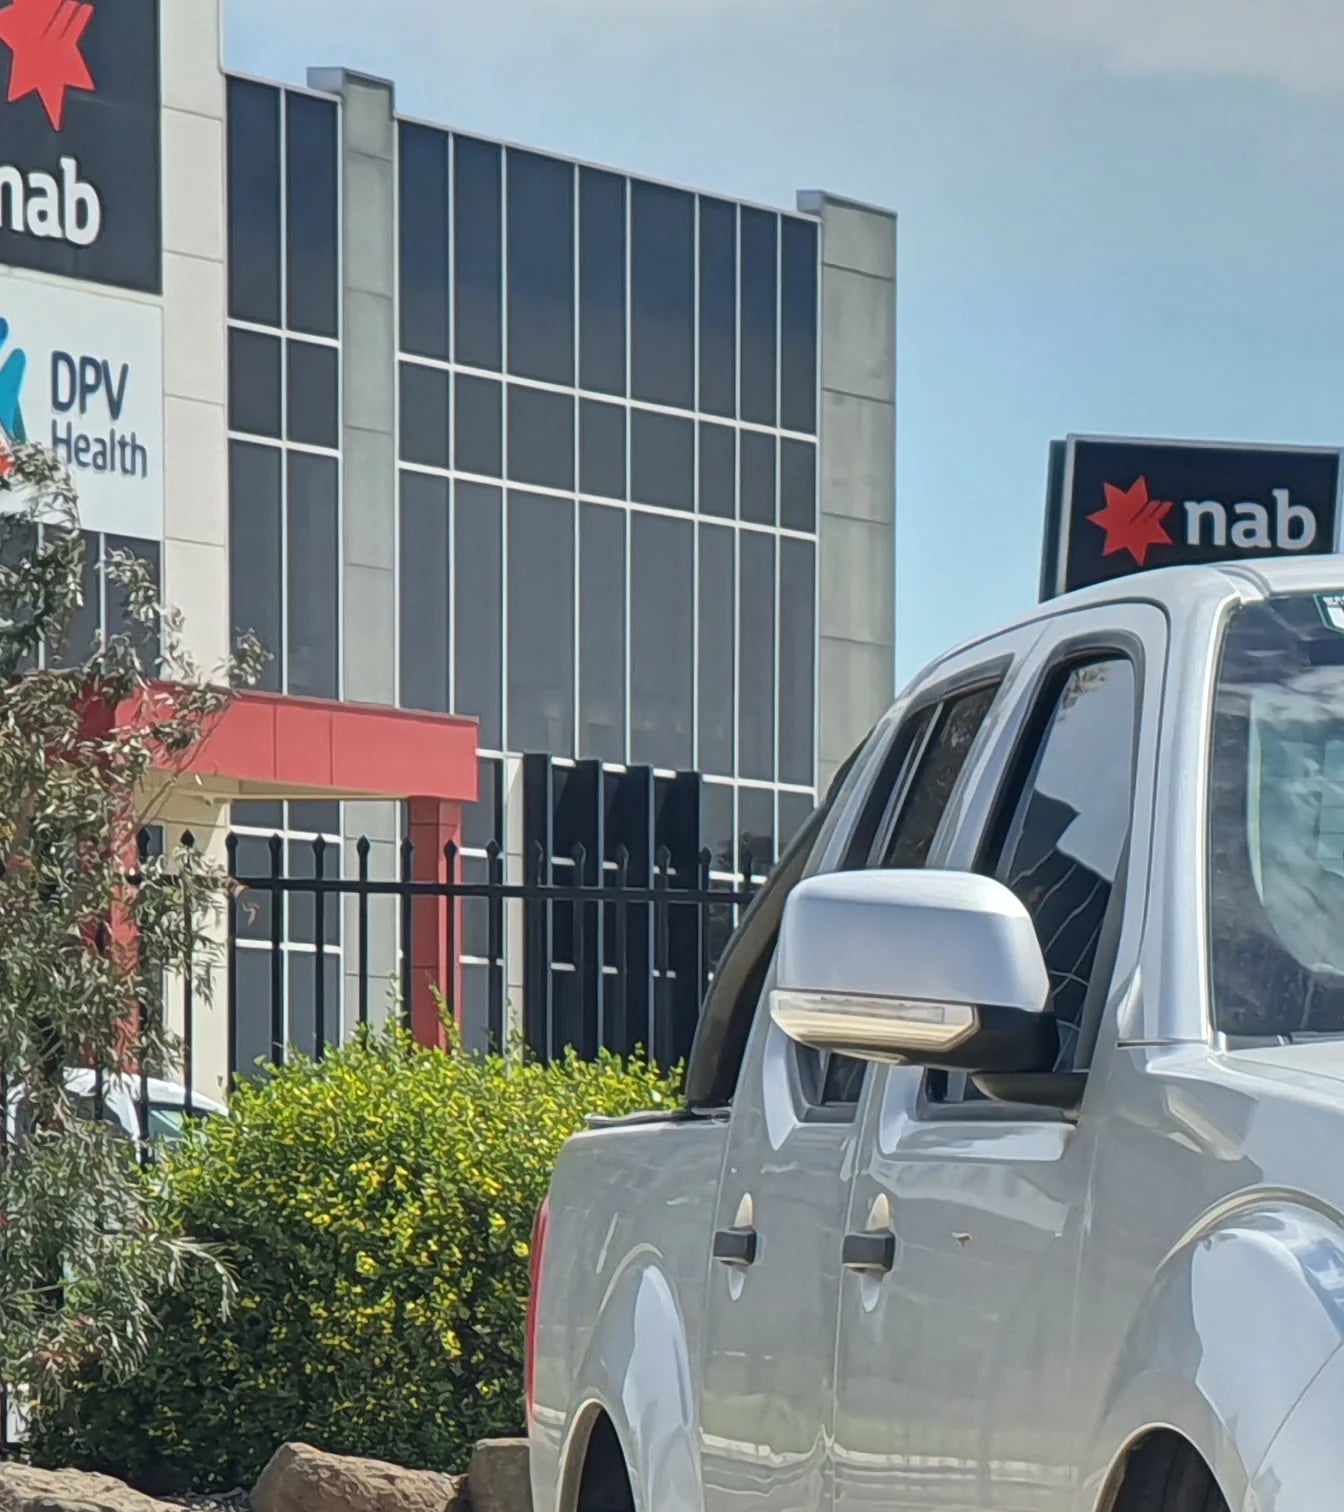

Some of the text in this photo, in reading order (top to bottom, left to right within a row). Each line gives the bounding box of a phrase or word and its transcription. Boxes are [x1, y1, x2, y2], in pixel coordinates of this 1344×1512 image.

[0, 156, 101, 246] nab
[51, 350, 129, 421] DPV
[51, 418, 148, 479] Health
[1184, 489, 1317, 551] nab
